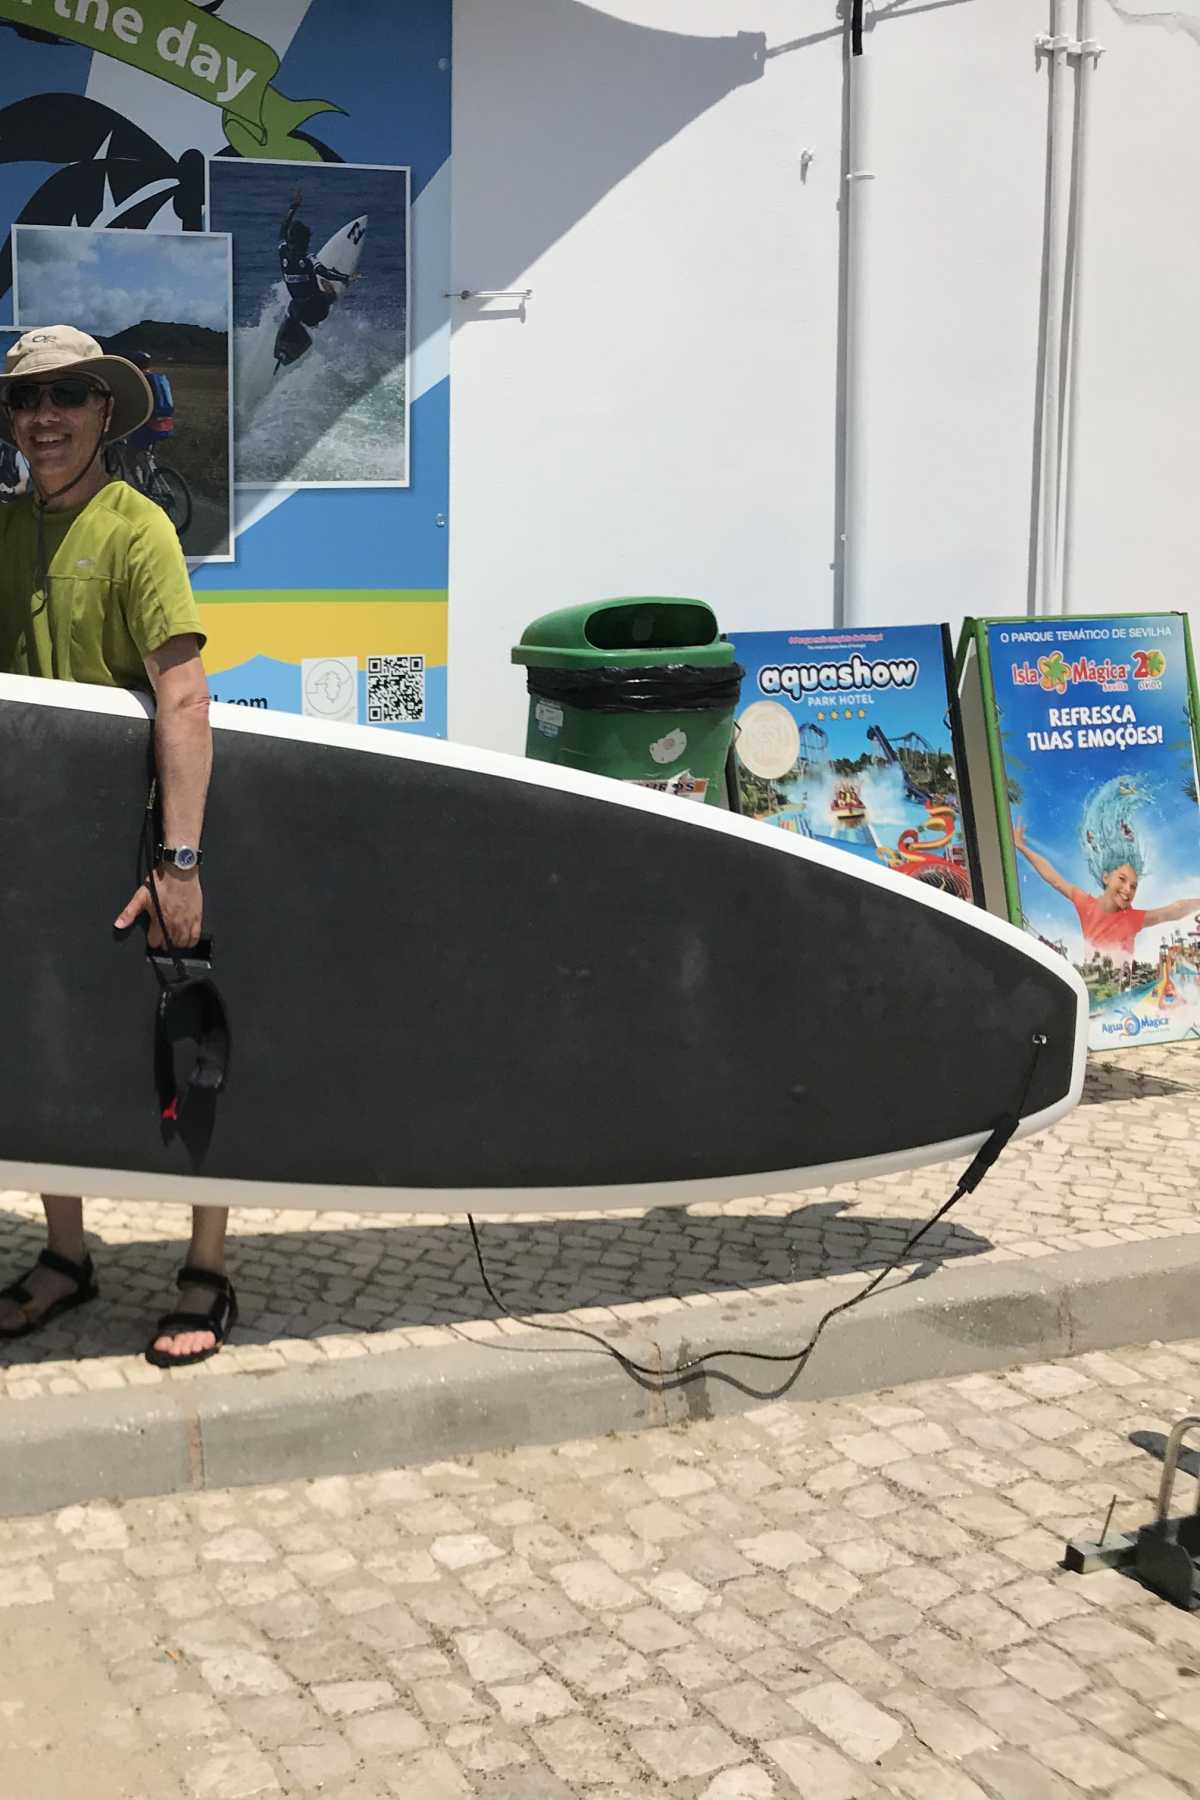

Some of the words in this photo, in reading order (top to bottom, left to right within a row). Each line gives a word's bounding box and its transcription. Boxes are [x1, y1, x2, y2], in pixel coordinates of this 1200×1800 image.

[156, 20, 256, 102] day
[1000, 633, 1009, 643] O
[1011, 631, 1054, 642] PARQUE
[1056, 628, 1110, 641] TEMÁTICO
[1112, 628, 1126, 639] DE
[1129, 626, 1173, 638] SEVILHA
[758, 653, 918, 702] aquashow
[1011, 660, 1039, 685] Isla
[1071, 657, 1128, 684] Mágica
[807, 695, 837, 707] PARK
[839, 694, 874, 705] HOTEL
[1049, 705, 1136, 727] REFRESCA
[1027, 730, 1074, 751] TUAS
[1077, 724, 1163, 751] EMOÇÕES!
